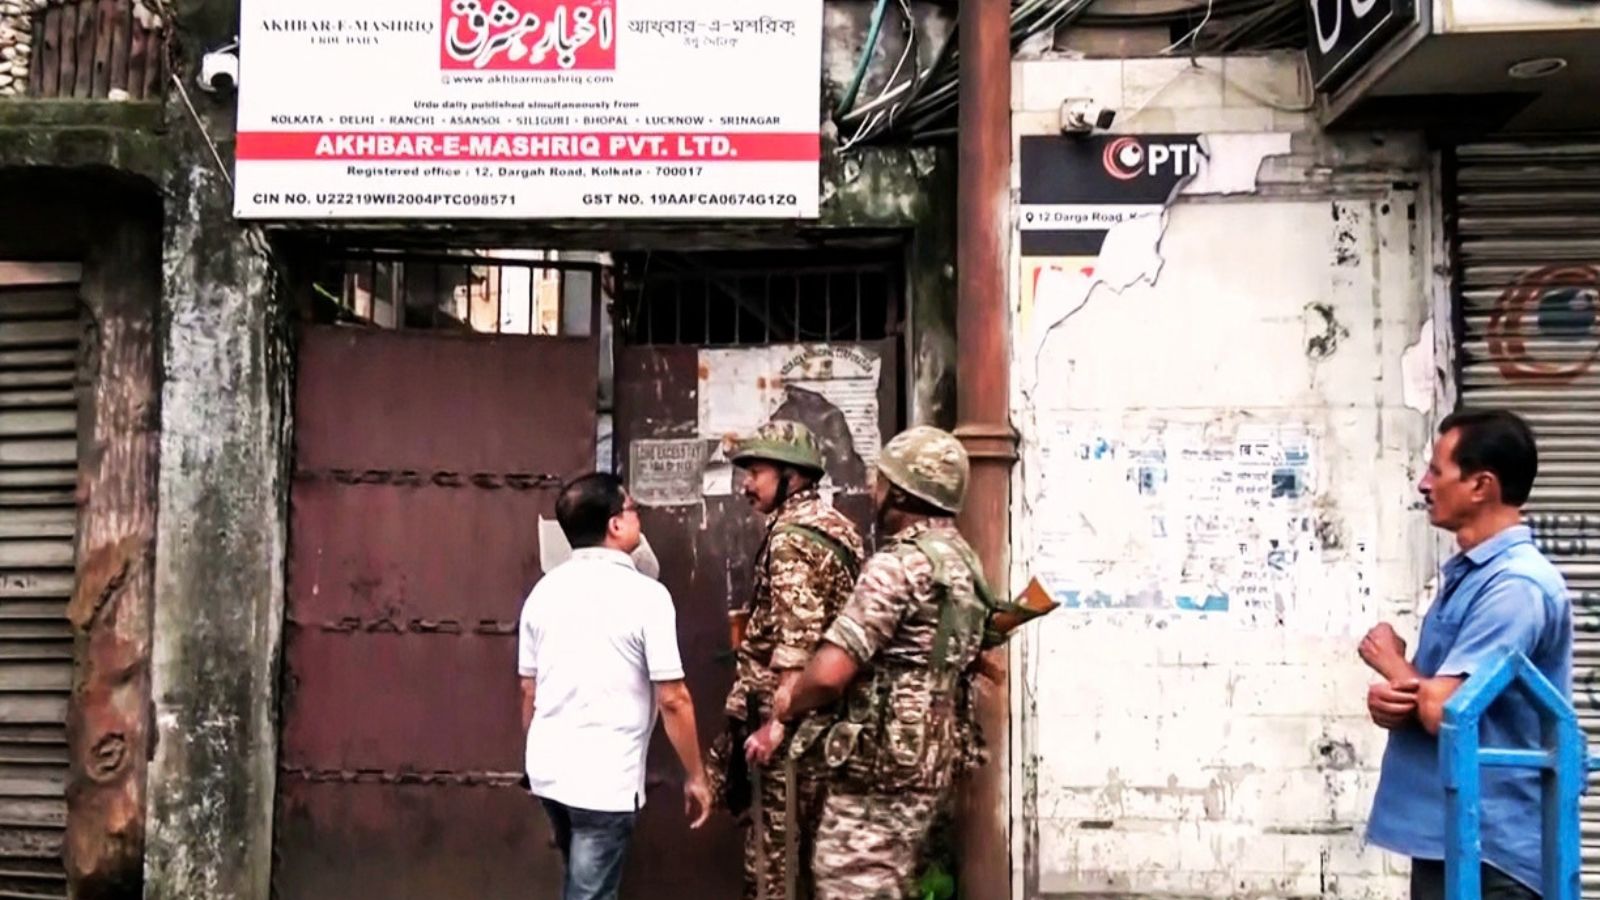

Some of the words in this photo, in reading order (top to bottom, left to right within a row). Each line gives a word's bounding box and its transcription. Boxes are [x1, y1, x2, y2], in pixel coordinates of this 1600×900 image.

[262, 19, 434, 34] AKHBAR-E-MASHRIQ
[413, 101, 439, 109] Urdu
[441, 100, 467, 110] daily
[471, 100, 525, 110] published
[527, 101, 610, 110] simultaneously
[613, 100, 639, 108] from
[271, 115, 324, 125] KOLKATA
[339, 115, 375, 125] DELHI
[389, 115, 435, 125] RANCHI
[450, 116, 500, 125] ASANSOL
[516, 116, 570, 126] SILIGURI
[583, 116, 628, 126] BHOPAL
[645, 116, 704, 126] LUCKNOW
[719, 116, 780, 126] SRINAGAR
[315, 135, 600, 157] AKHBAR-E-MASHRIQ
[609, 136, 668, 157] PVT.
[677, 136, 738, 157] LTD.
[346, 165, 419, 178] Registered
[423, 166, 461, 177] office
[475, 166, 494, 179] 12,
[498, 167, 545, 179] Dargah
[549, 166, 587, 179] Road,
[591, 166, 643, 177] Kolkata
[656, 166, 704, 177] 700017
[252, 193, 280, 205] CIN
[284, 193, 311, 205] NO.
[582, 193, 613, 205] GST
[617, 193, 645, 206] NO.
[1038, 212, 1051, 222] 12
[1054, 212, 1089, 224] Darga
